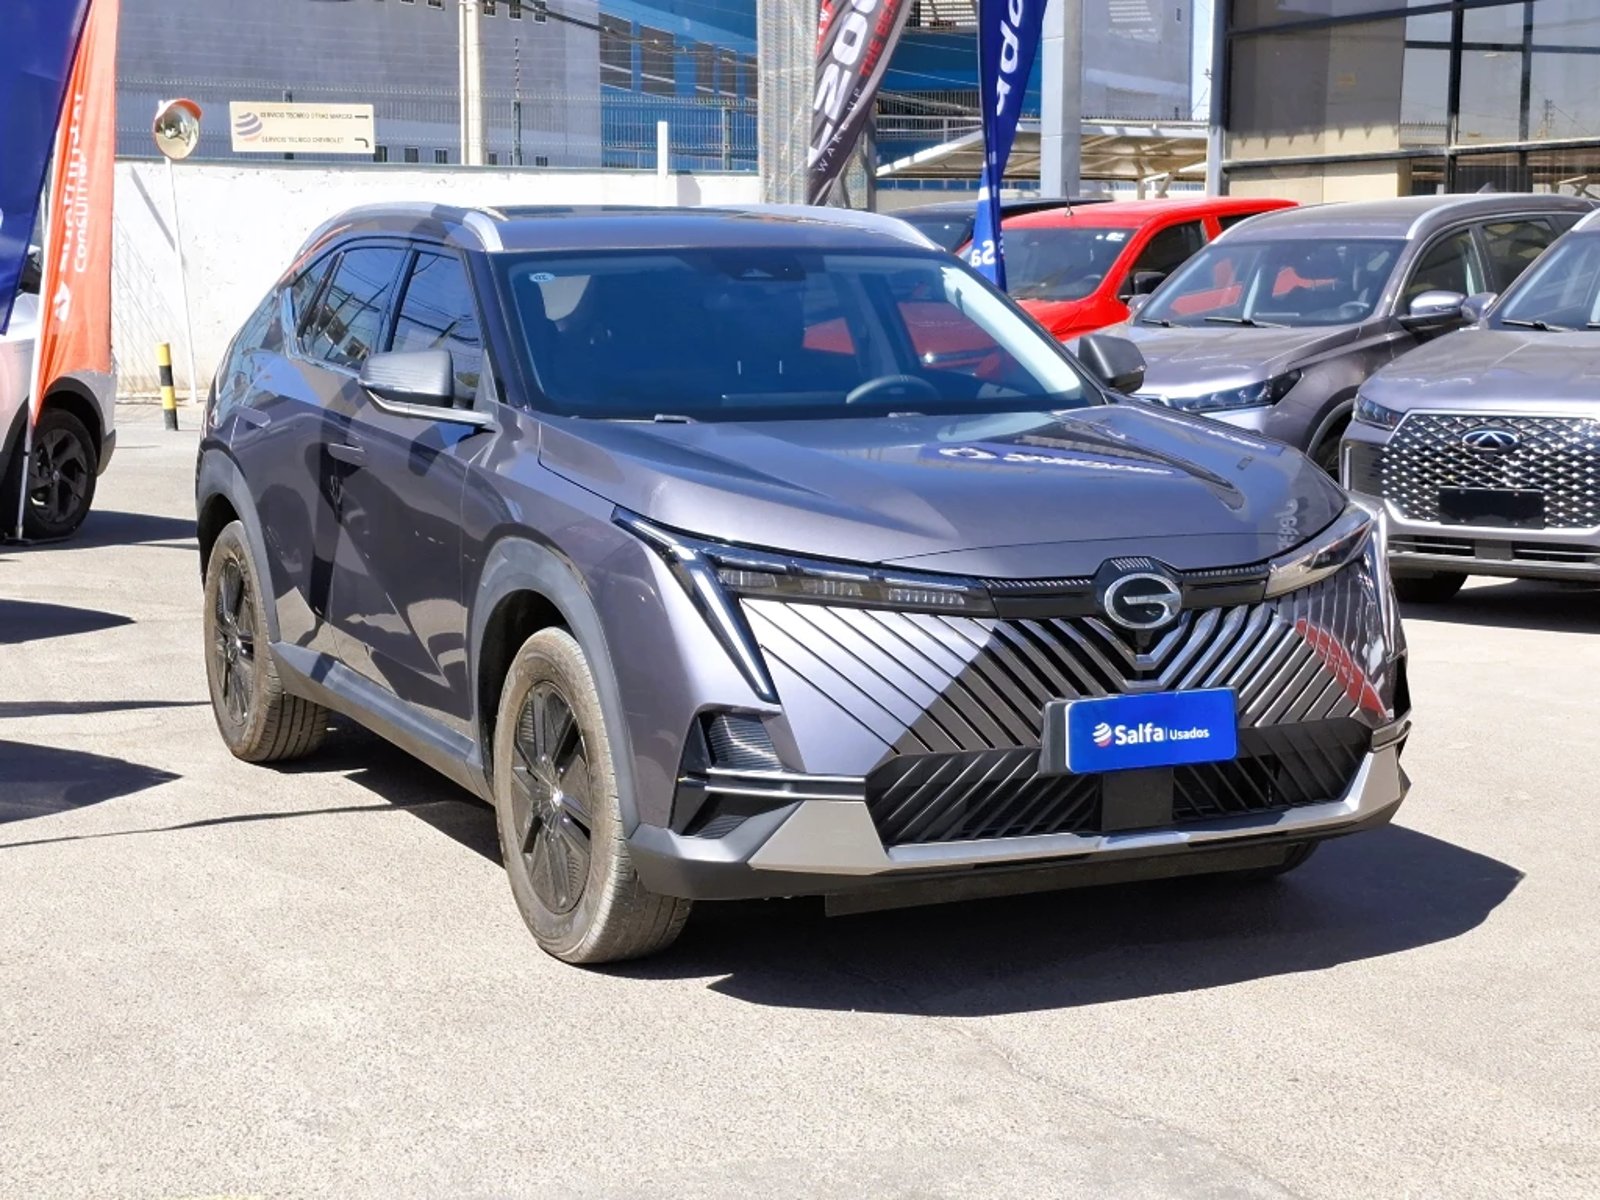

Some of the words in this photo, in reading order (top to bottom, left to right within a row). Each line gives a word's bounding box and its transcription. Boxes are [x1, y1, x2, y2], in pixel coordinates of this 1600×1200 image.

[859, 37, 883, 77] THE
[817, 123, 850, 173] WAKE
[847, 88, 862, 112] UP
[74, 152, 89, 273] Consumer
[1114, 722, 1165, 746] Salfa
[1169, 726, 1210, 741] Usados
